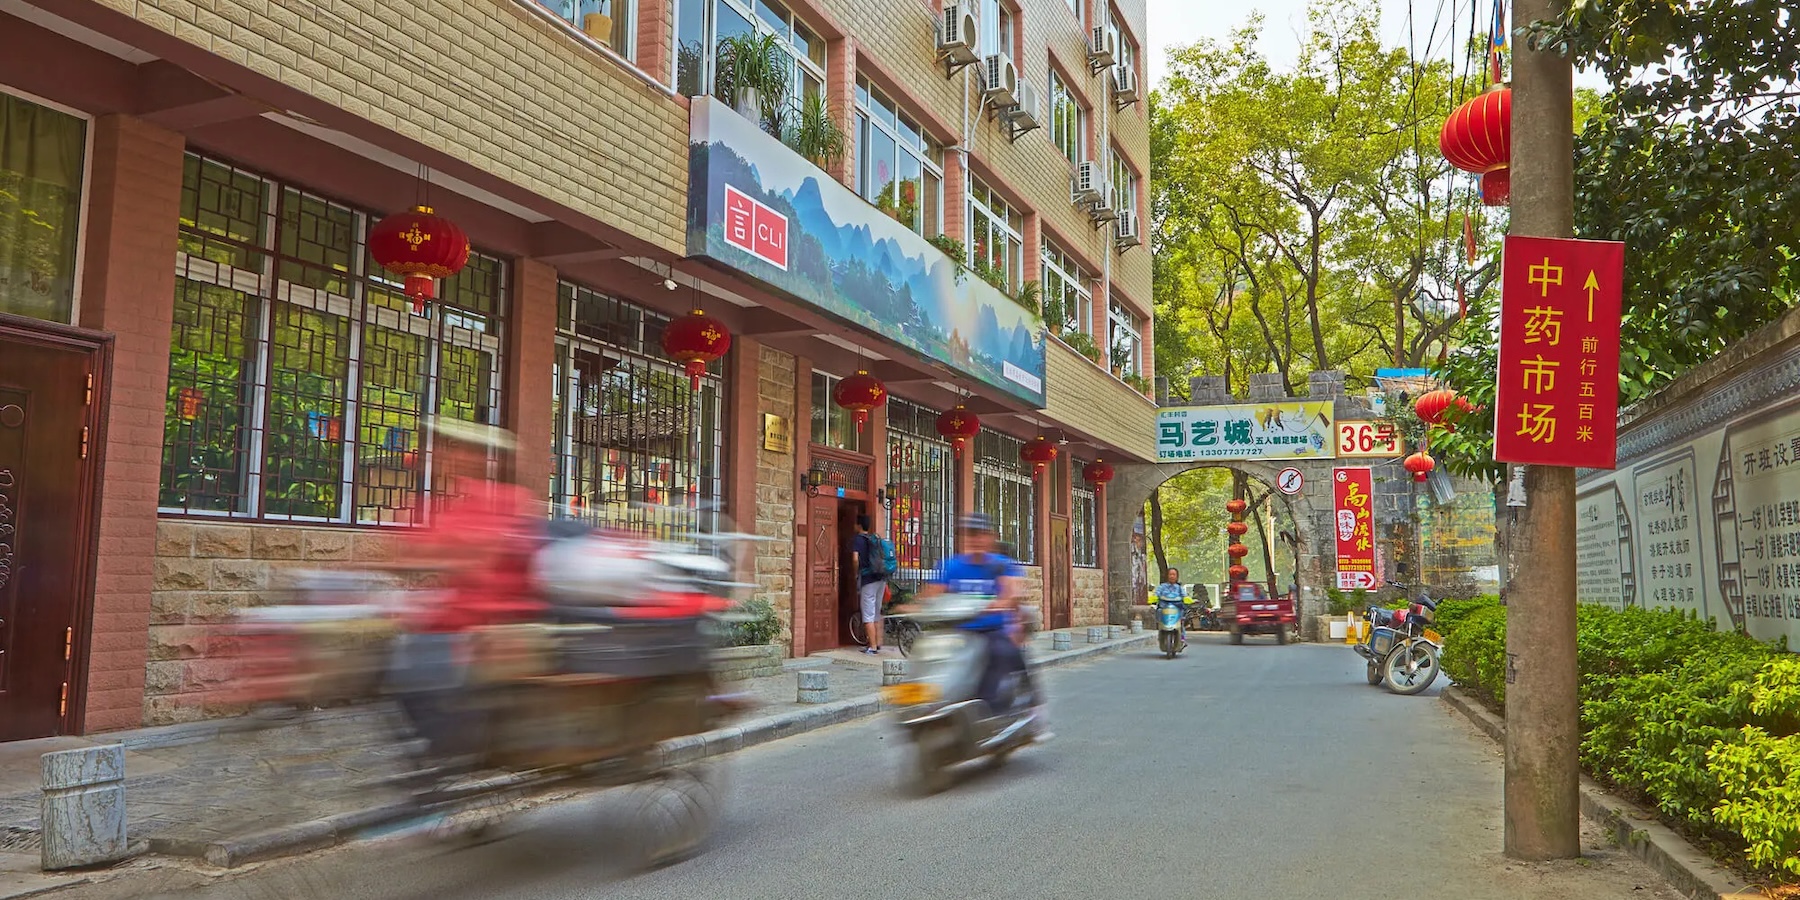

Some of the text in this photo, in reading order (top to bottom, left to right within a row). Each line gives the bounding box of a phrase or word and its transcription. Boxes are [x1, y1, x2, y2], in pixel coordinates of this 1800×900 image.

[730, 200, 782, 249] 言 CLI
[1515, 257, 1564, 444] 中药市场
[1576, 336, 1599, 442] 前行五百米
[1159, 420, 1253, 448] 马艺城
[1200, 448, 1263, 457] 13307737727
[1255, 435, 1308, 445] 五人制足球场
[1743, 436, 1800, 476] 开班设置
